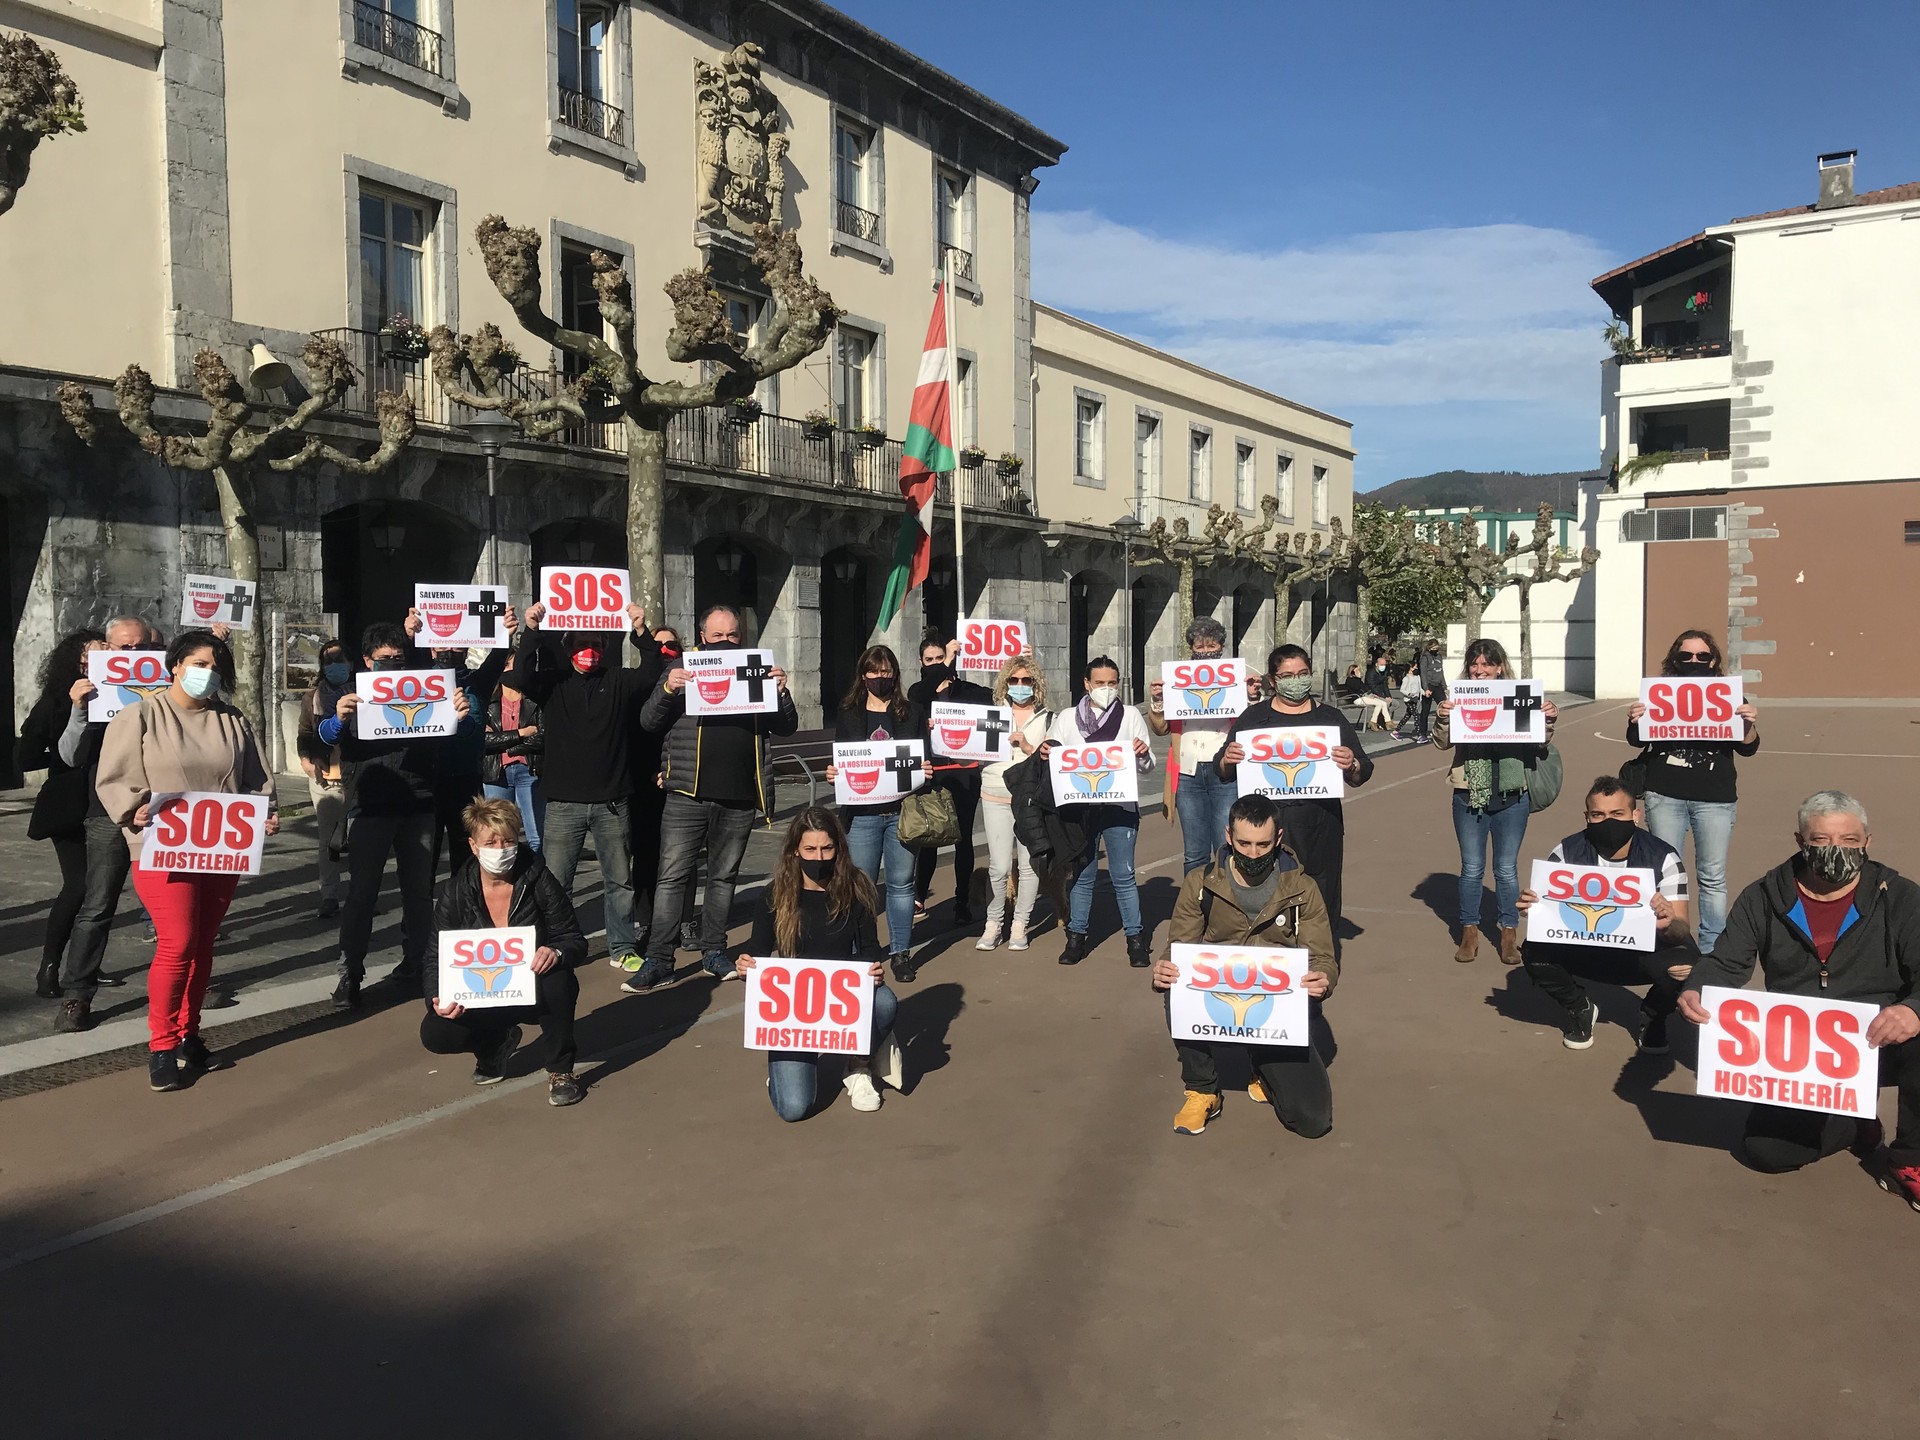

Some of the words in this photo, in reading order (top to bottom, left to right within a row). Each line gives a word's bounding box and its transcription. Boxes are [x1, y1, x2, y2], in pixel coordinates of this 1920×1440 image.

[189, 582, 216, 590] SALVEMOS
[549, 572, 623, 612] SOS
[231, 595, 248, 603] RIP
[419, 591, 455, 599] SALVEMOS
[478, 604, 499, 613] RIP
[548, 614, 623, 629] HOSTELERÍA
[965, 624, 1022, 656] SOS
[688, 657, 722, 666] SALVEMOS
[962, 658, 1005, 670] HOSTELE
[106, 656, 171, 684] SO
[698, 668, 736, 677] HOSTELERIA
[746, 668, 766, 677] RIP
[1174, 663, 1236, 688] SOS
[372, 675, 446, 703] SOS
[1454, 698, 1461, 706] LA
[1463, 698, 1503, 706] HOSTELERIA
[1513, 699, 1535, 707] RIP
[1648, 683, 1733, 723] SOS
[935, 708, 966, 716] SALVEMOS
[1176, 708, 1236, 717] OSTALARITZA
[942, 718, 977, 726] HOSTELERIA
[985, 721, 1003, 729] RIP
[373, 725, 445, 736] OSTALARITZA
[1649, 723, 1734, 739] HOSTELERÍA
[837, 748, 872, 757] SALVEMOS
[1251, 731, 1328, 762] SOS
[847, 759, 885, 768] HOSTELERIA
[894, 759, 915, 768] RIP
[1061, 745, 1124, 772] SOS
[1063, 791, 1126, 800] OSTALARITZA
[1254, 786, 1329, 796] OSTALARITZA
[157, 798, 256, 851] SOS
[152, 850, 250, 872] HOSTELERÍA
[1547, 869, 1641, 906] SOS
[1546, 928, 1636, 945] OSTALARITZA
[453, 937, 525, 967] SOS
[1191, 952, 1291, 993] SOS
[453, 990, 523, 1001] OSTALARITZA
[759, 966, 861, 1026] SOS
[1192, 1024, 1289, 1040] OSTALARITZA
[755, 1027, 858, 1051] HOSTELERÍA
[1718, 998, 1860, 1080] SOS
[1714, 1069, 1859, 1113] HOSTELERÍA
